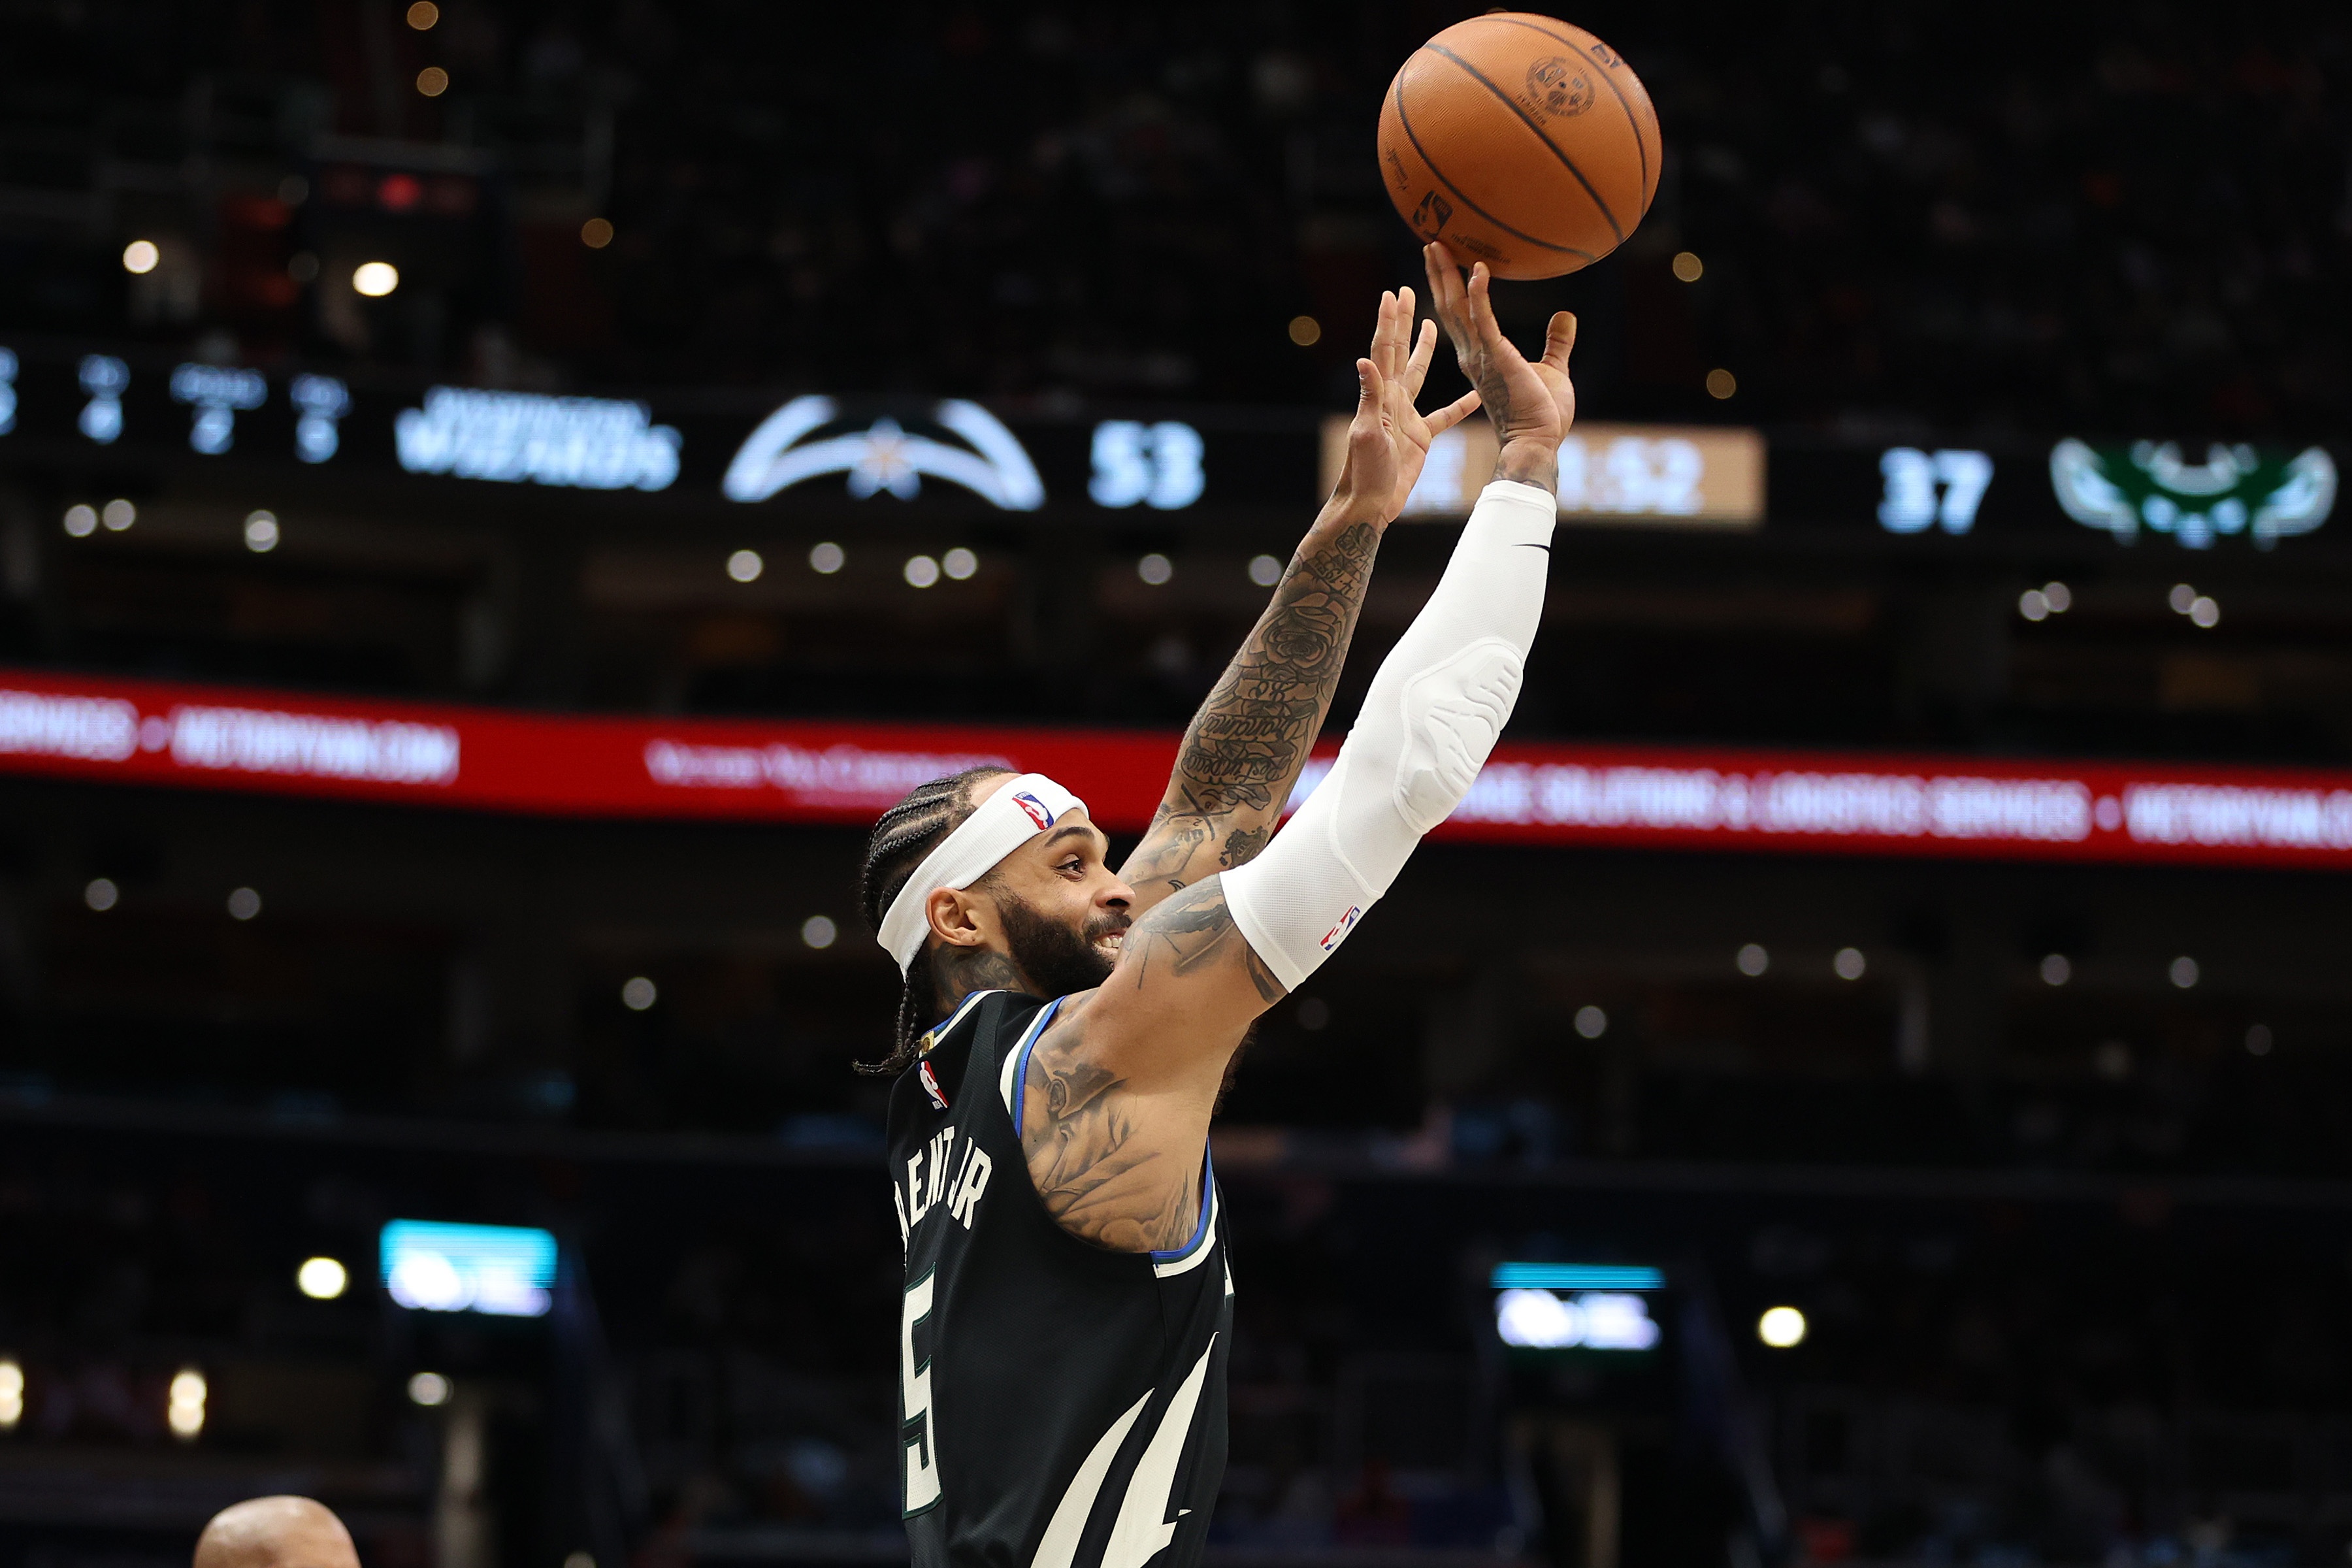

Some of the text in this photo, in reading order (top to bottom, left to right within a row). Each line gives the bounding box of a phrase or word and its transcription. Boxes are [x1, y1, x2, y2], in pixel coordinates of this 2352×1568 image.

[1086, 418, 1206, 510] 53
[1876, 447, 1995, 535] 37
[947, 1136, 992, 1230] JR
